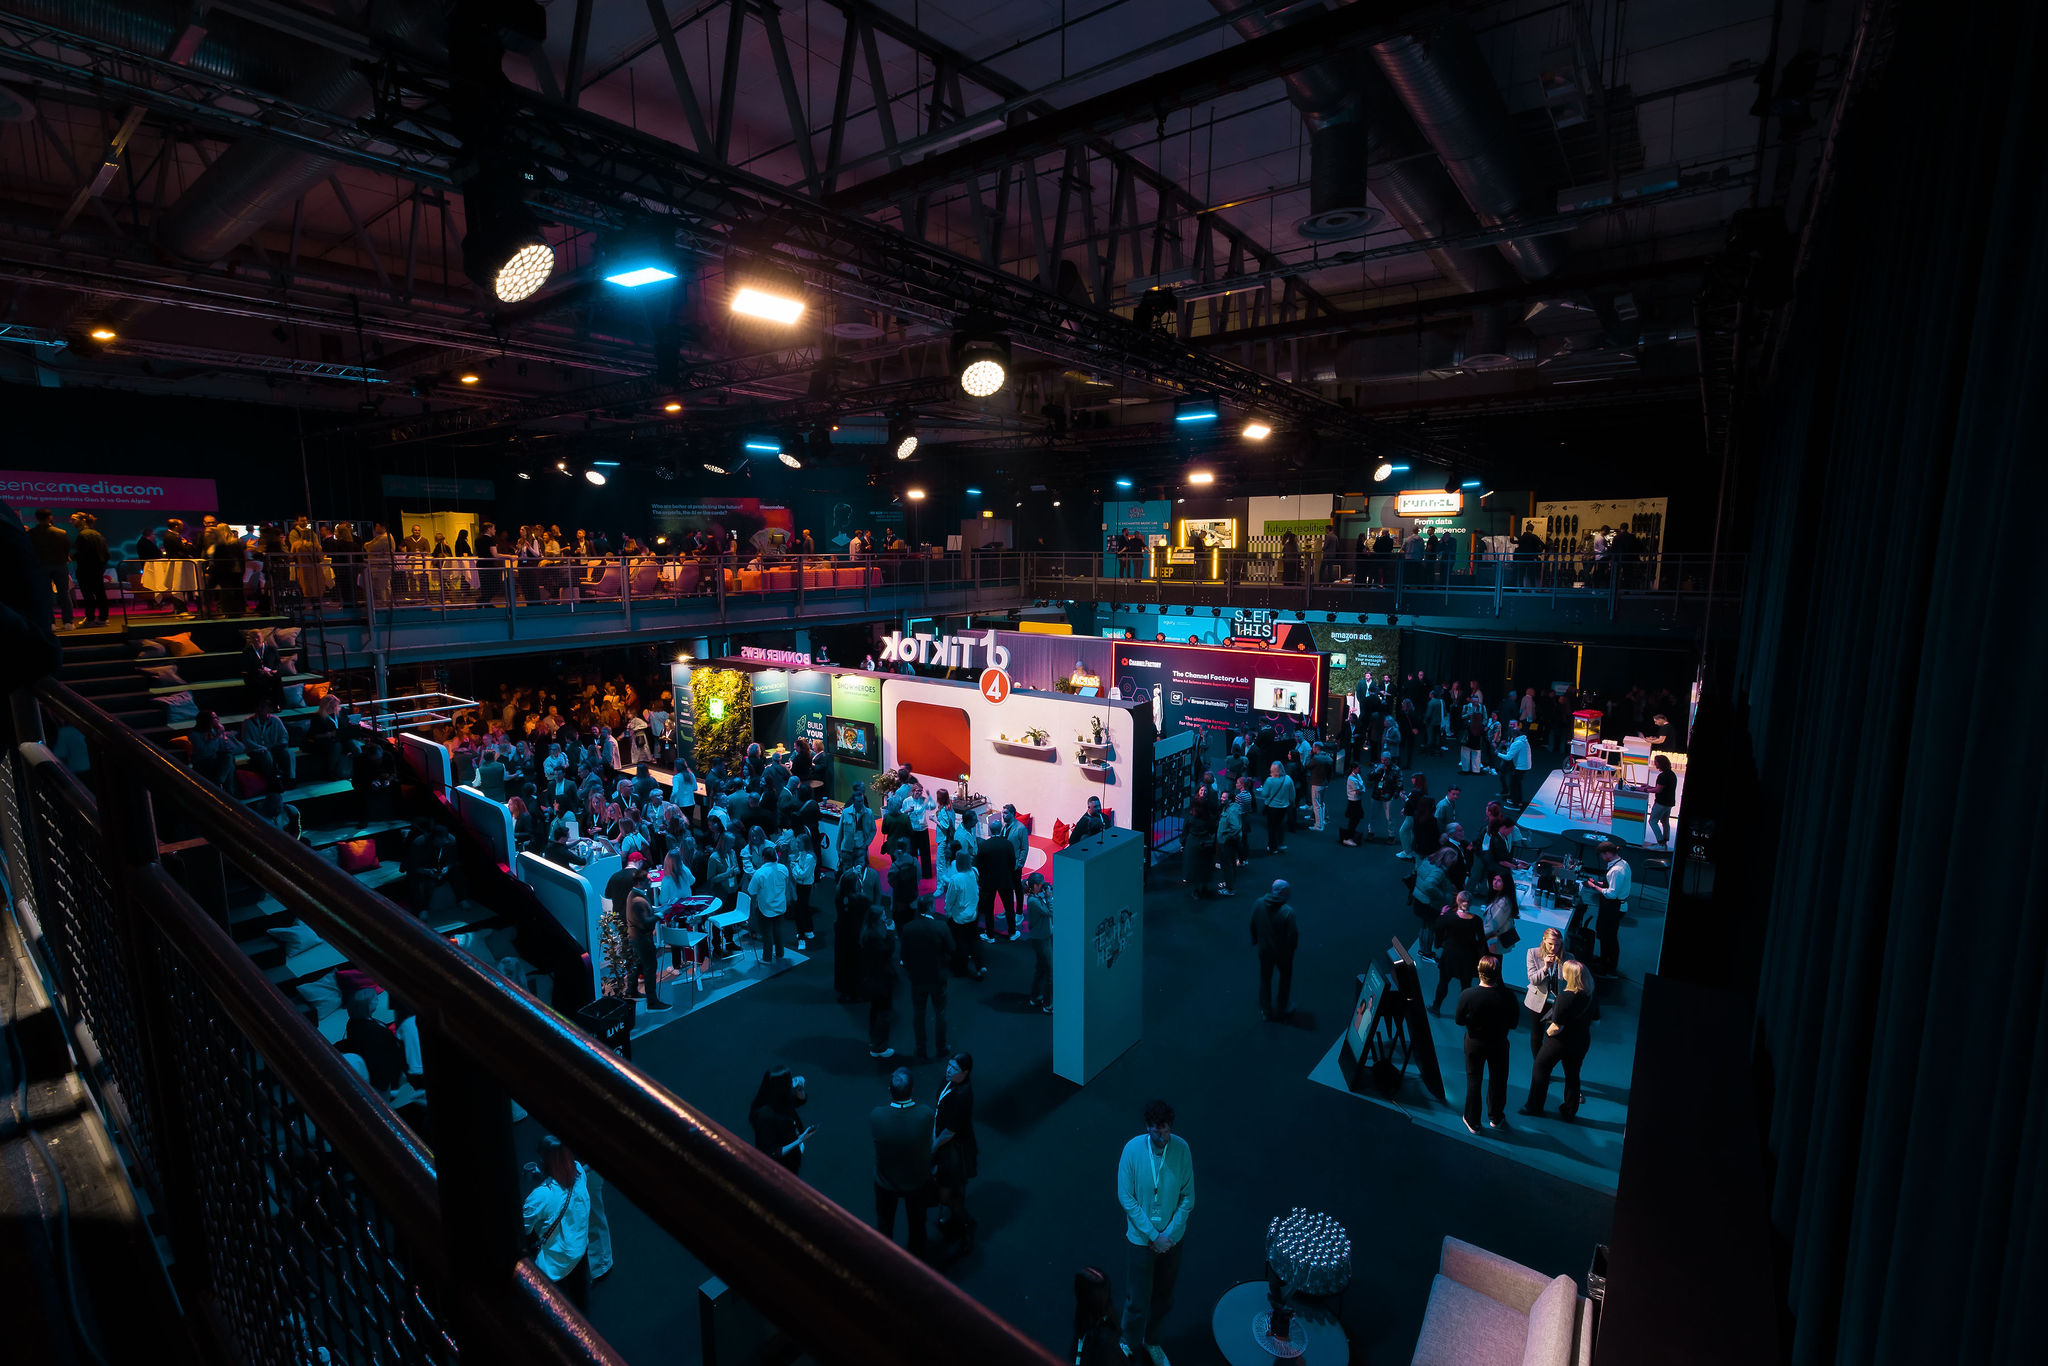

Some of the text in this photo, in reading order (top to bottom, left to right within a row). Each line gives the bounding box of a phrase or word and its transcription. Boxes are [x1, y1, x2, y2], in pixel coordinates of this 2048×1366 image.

[1267, 522, 1324, 533] future realitie
[1234, 623, 1272, 637] THIS
[1331, 632, 1373, 642] amazon ads
[1185, 671, 1210, 680] Channel
[1210, 674, 1236, 683] Factory
[986, 672, 1002, 700] 4
[1205, 700, 1229, 709] Suitability
[807, 721, 824, 730] BUILD
[806, 729, 824, 738] YOUR
